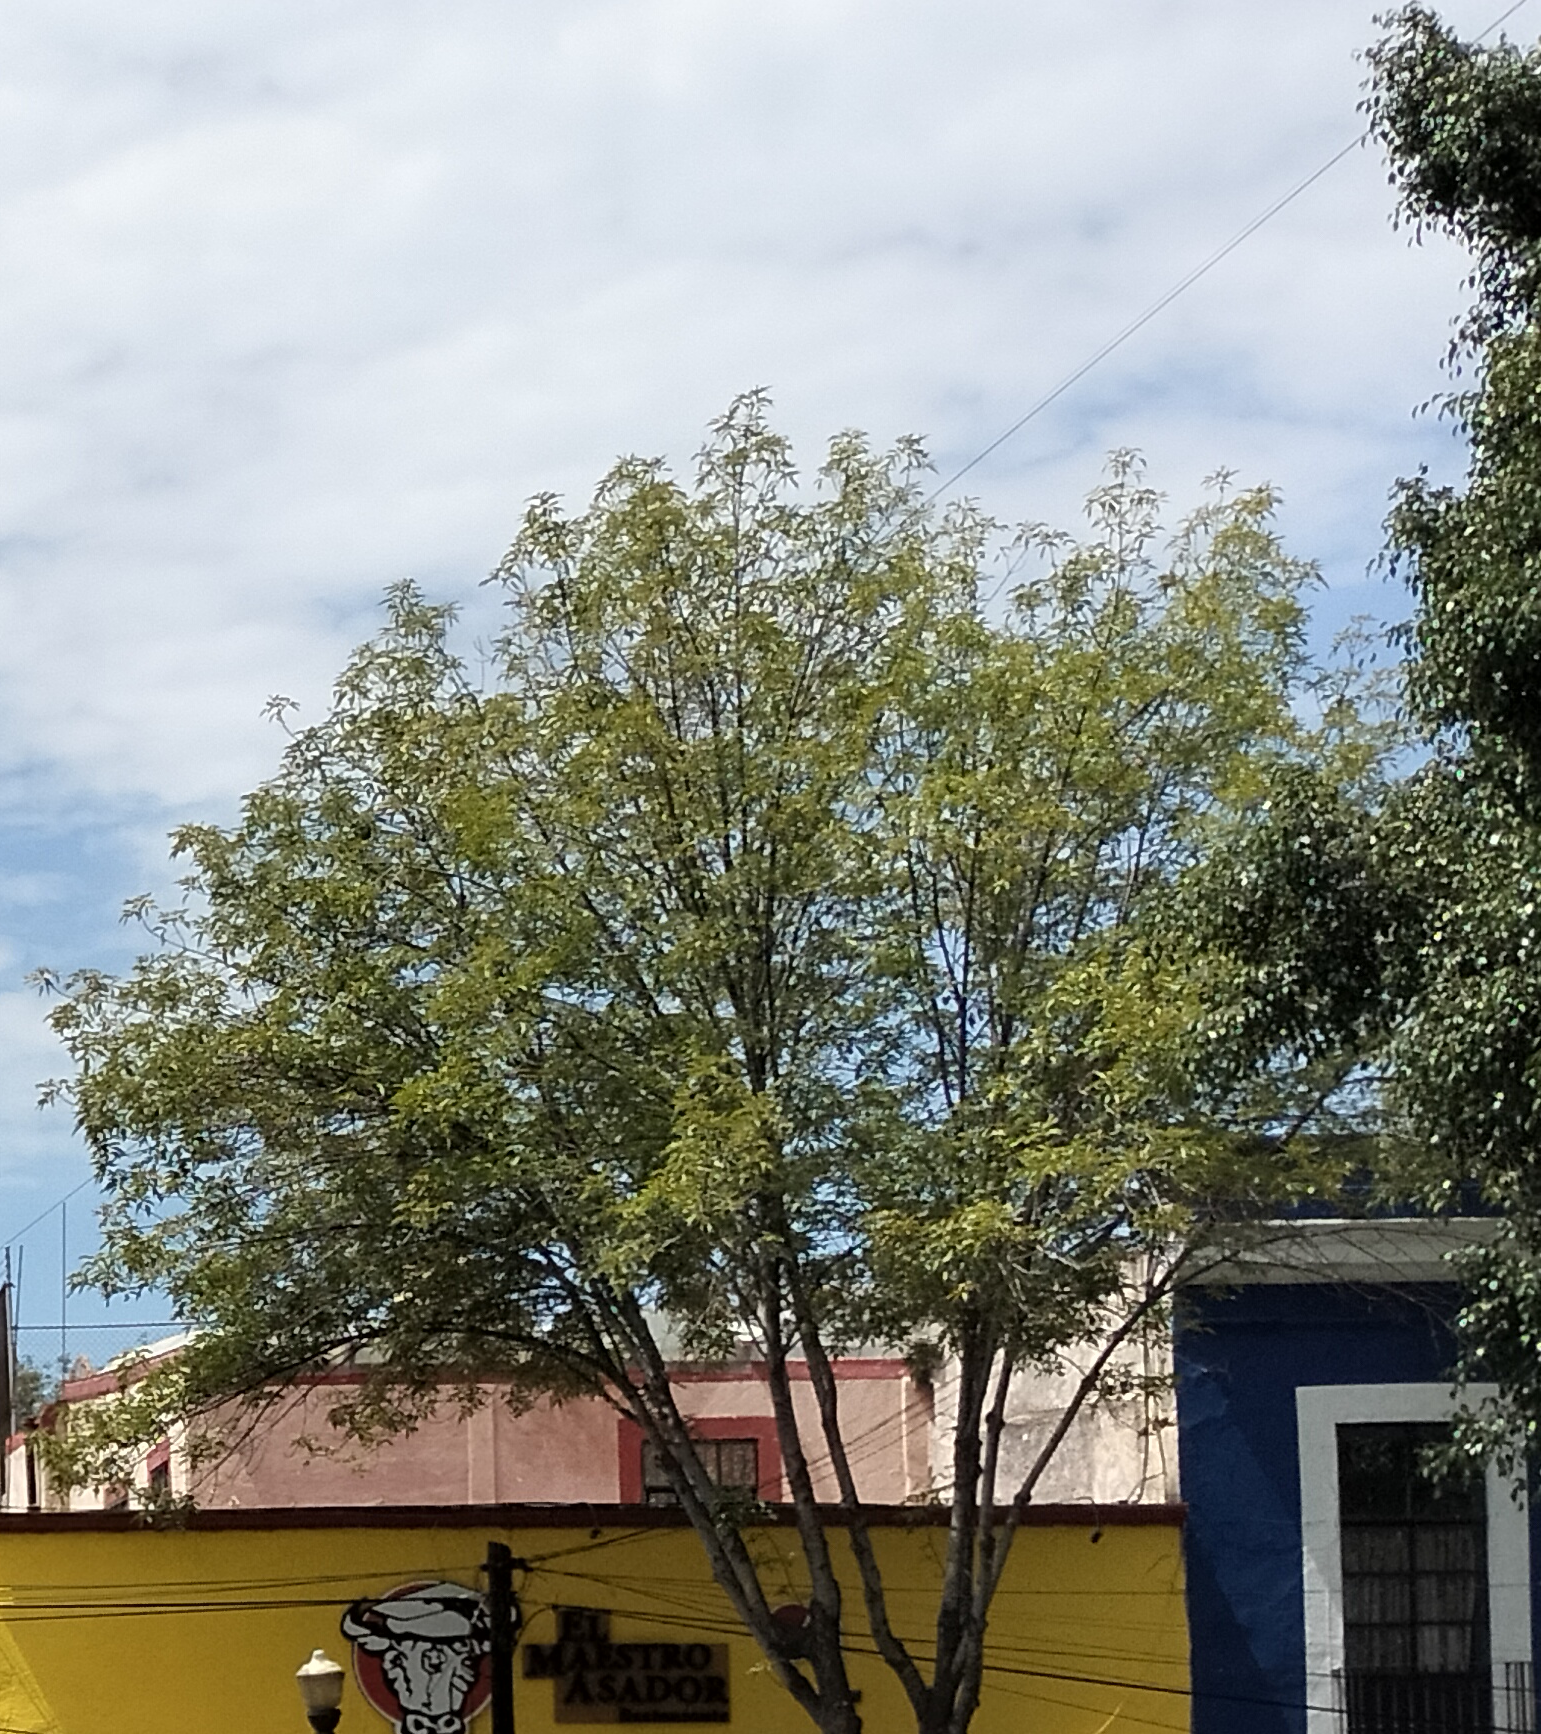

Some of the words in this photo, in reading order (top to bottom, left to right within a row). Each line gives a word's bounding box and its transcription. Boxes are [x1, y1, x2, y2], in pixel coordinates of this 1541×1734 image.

[560, 1611, 608, 1642] EL
[524, 1644, 711, 1676] MAESTRO
[565, 1670, 729, 1705] ASADOR
